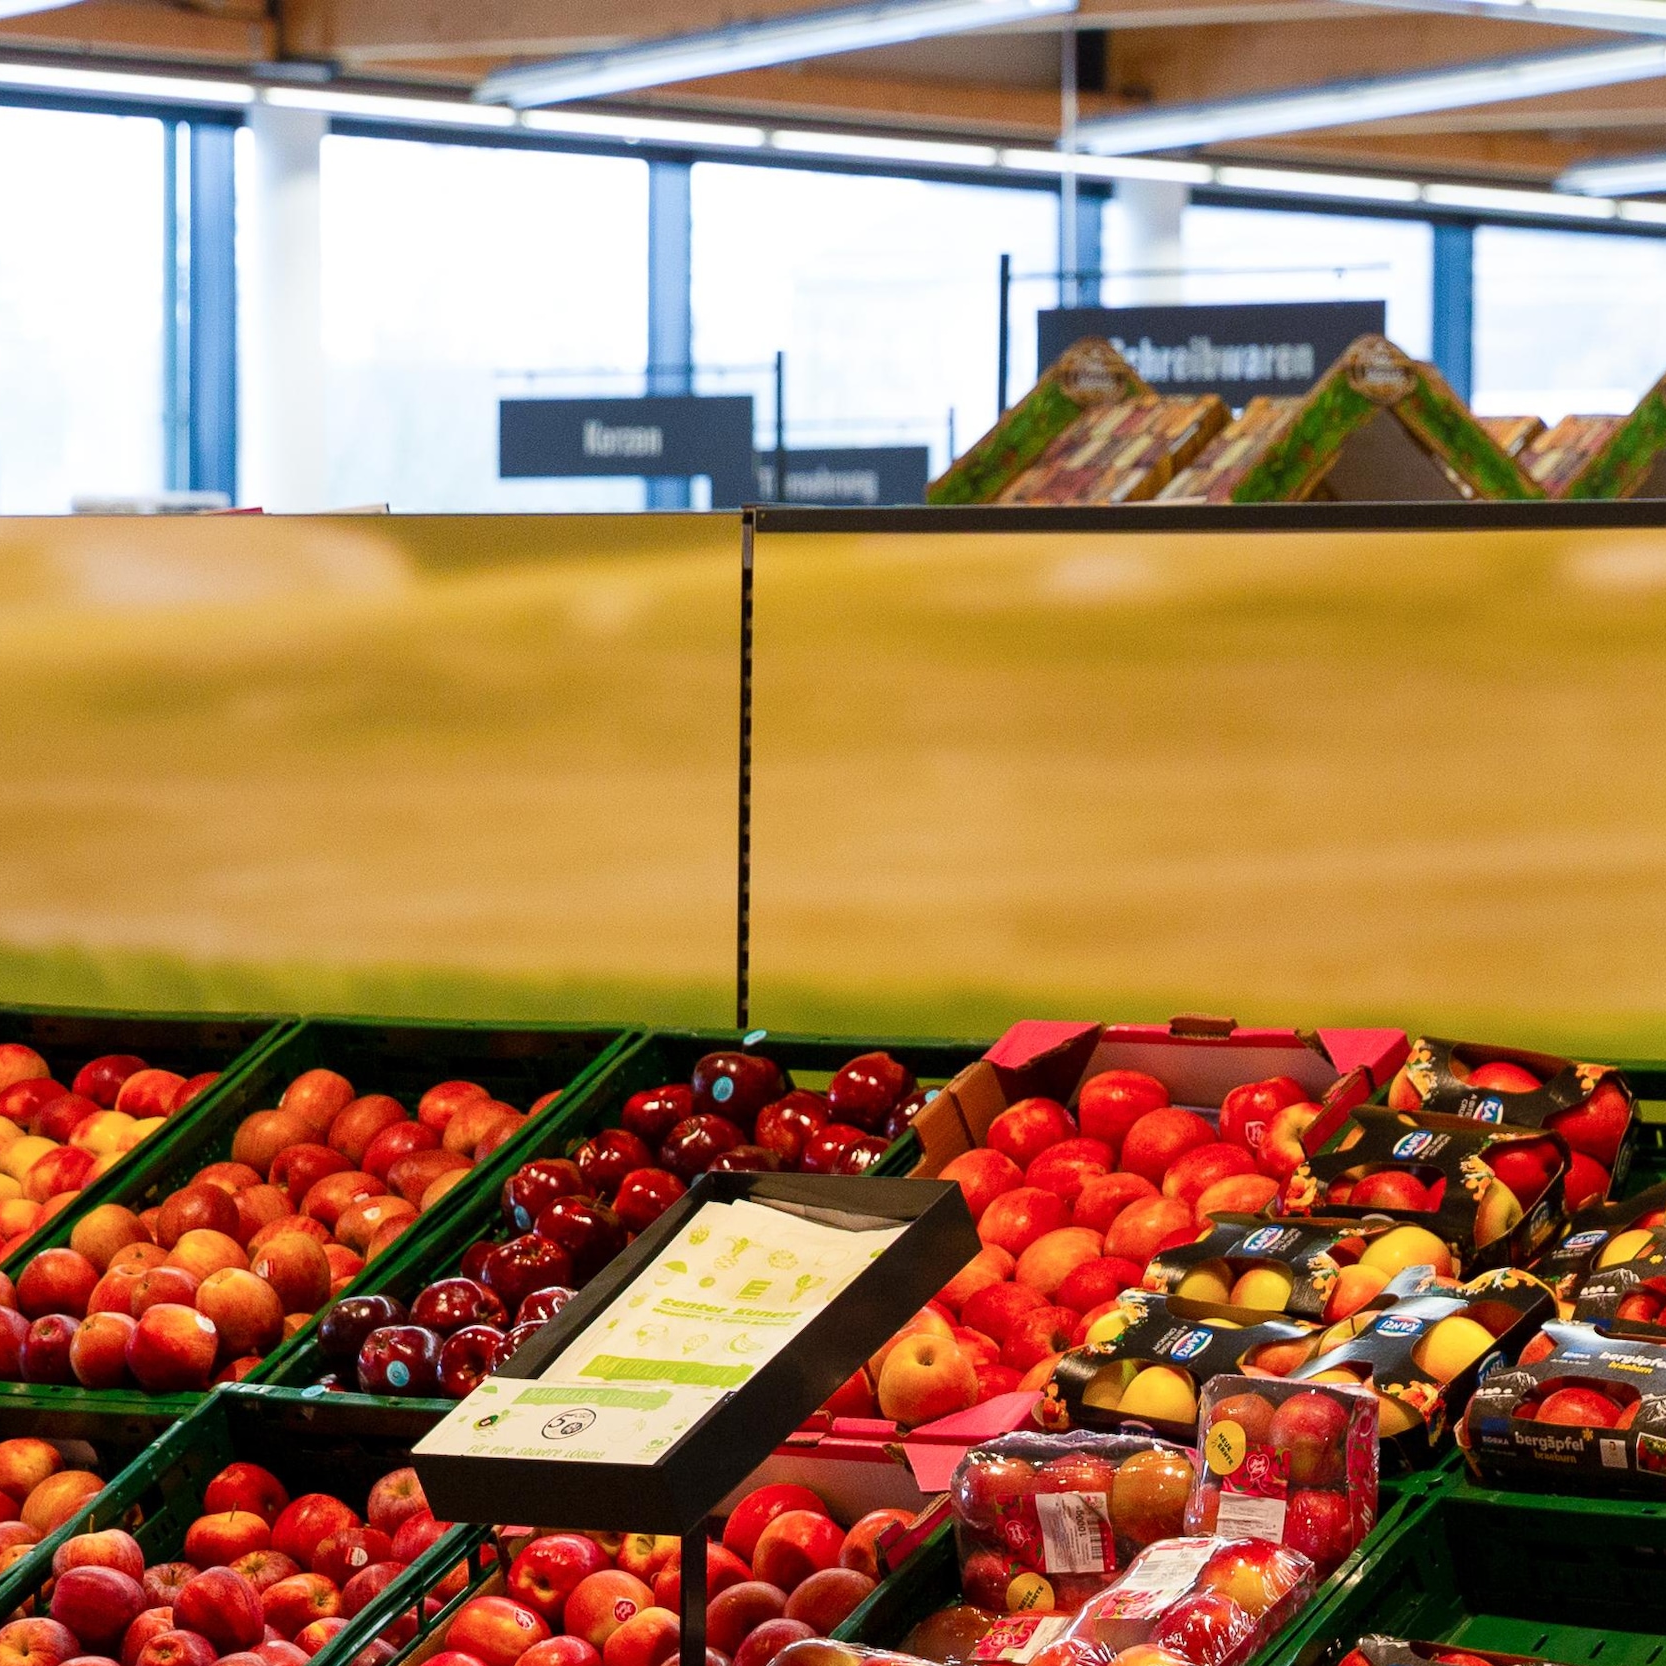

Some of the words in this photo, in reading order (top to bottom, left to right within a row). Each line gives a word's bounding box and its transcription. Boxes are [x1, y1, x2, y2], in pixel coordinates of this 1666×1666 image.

[1217, 1432, 1233, 1452] NEUE
[1514, 1430, 1584, 1452] bergäpfel
[1533, 1449, 1577, 1464] braeburn
